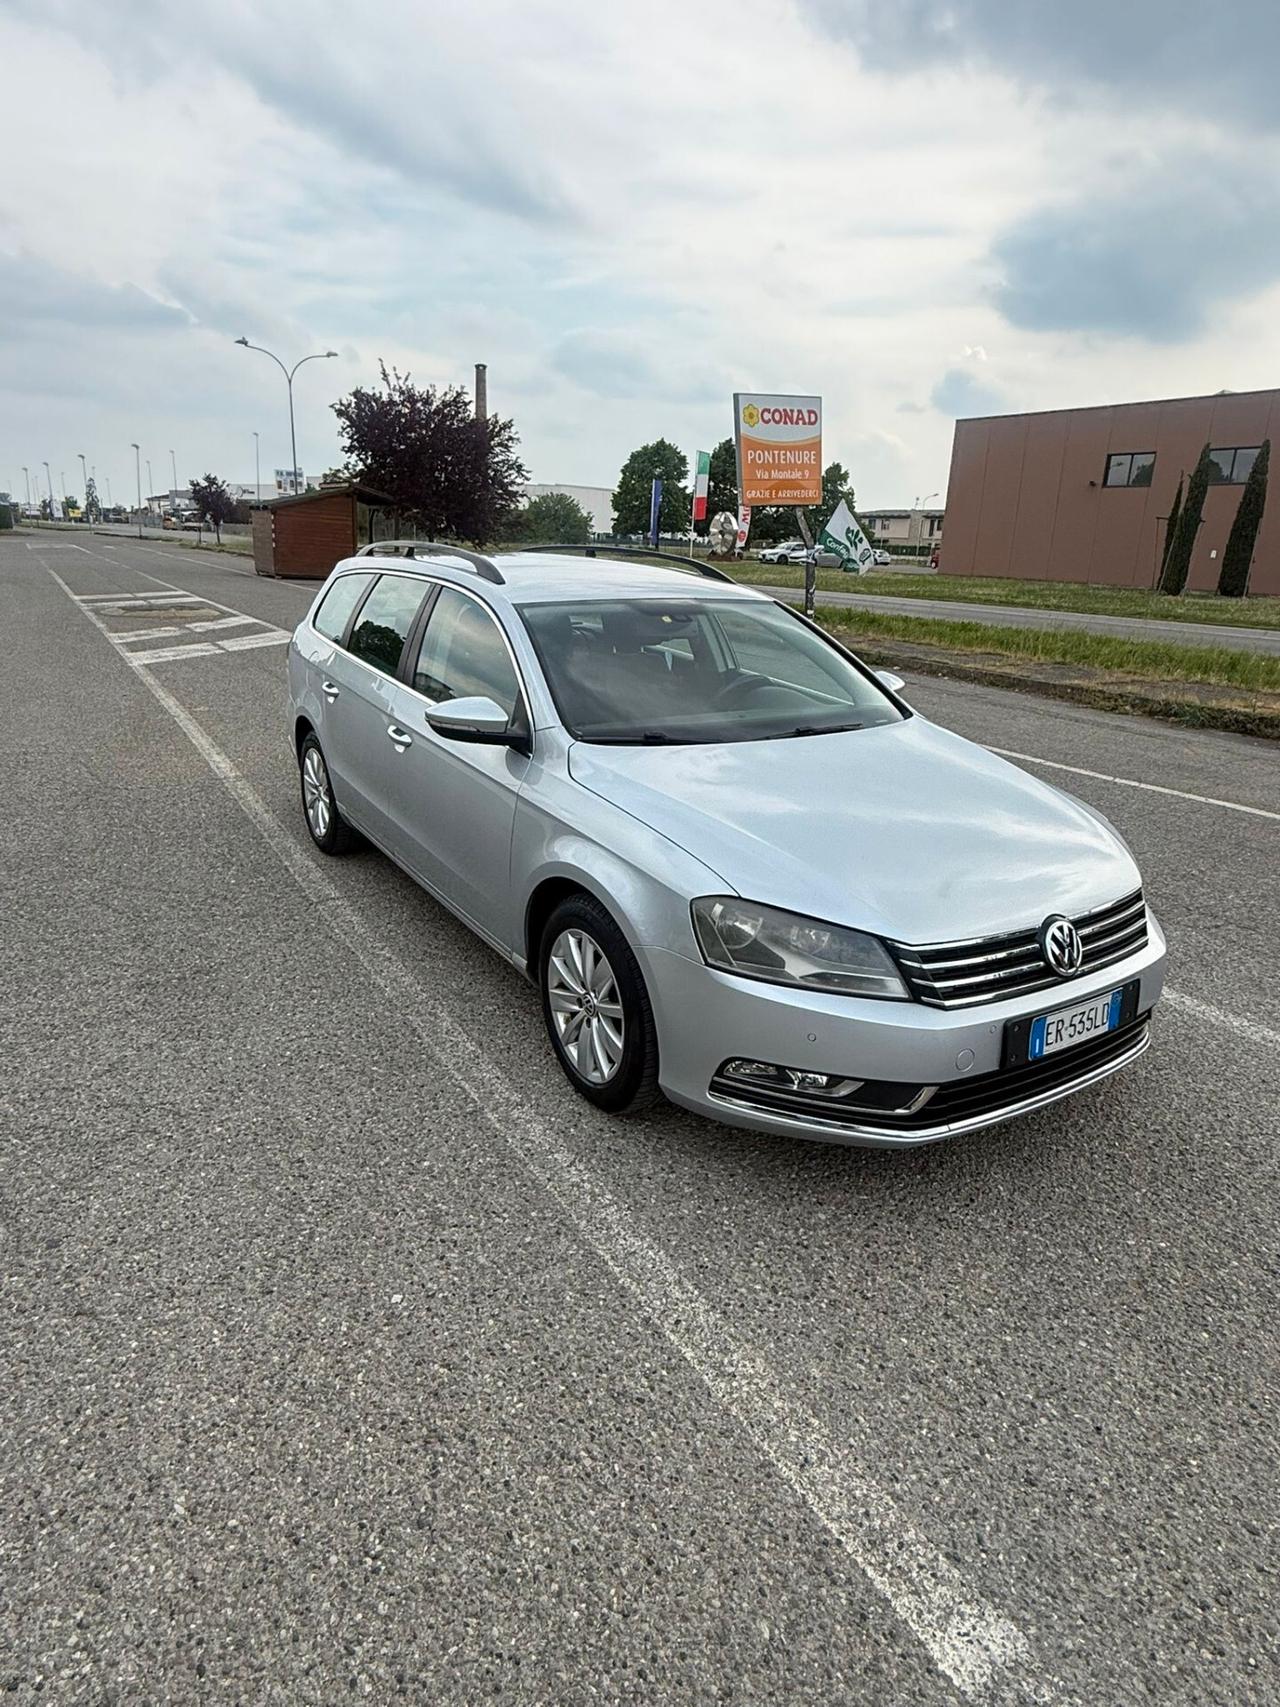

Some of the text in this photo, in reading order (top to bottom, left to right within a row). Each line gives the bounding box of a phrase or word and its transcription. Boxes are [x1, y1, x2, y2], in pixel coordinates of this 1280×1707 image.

[760, 407, 818, 426] CONAD
[747, 449, 817, 464] PONTENURE
[755, 468, 810, 479] Via Montale 9
[746, 489, 819, 498] GRAZIE E ARRIVEDERCI
